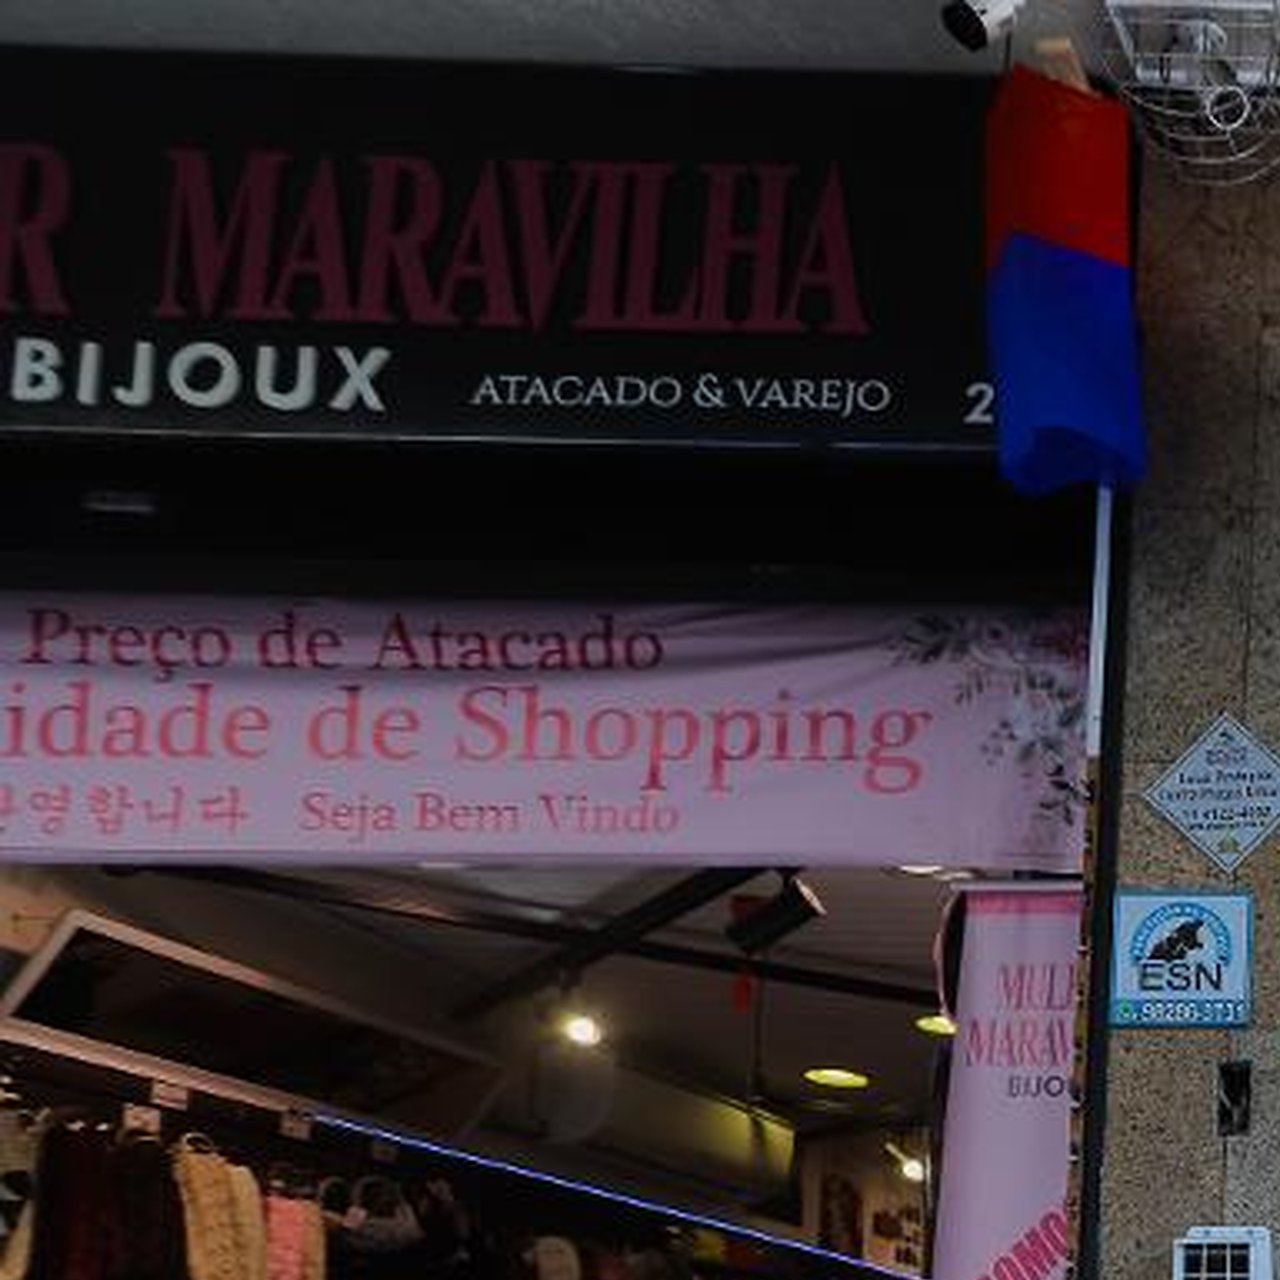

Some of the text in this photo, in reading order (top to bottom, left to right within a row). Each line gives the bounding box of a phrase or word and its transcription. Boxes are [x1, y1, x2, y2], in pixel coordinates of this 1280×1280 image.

[154, 144, 872, 337] MARAVILHA
[10, 335, 393, 412] BIJOUX
[471, 375, 683, 408] ATACADO
[691, 372, 725, 410] &
[735, 376, 893, 417] VAREJO
[22, 606, 664, 683] Preço de Atacado
[306, 683, 421, 761] de
[455, 682, 934, 795] Shopping
[300, 791, 680, 842] Seja Bem Vindo
[997, 962, 1075, 1012] MUL
[1139, 962, 1223, 992] ESN
